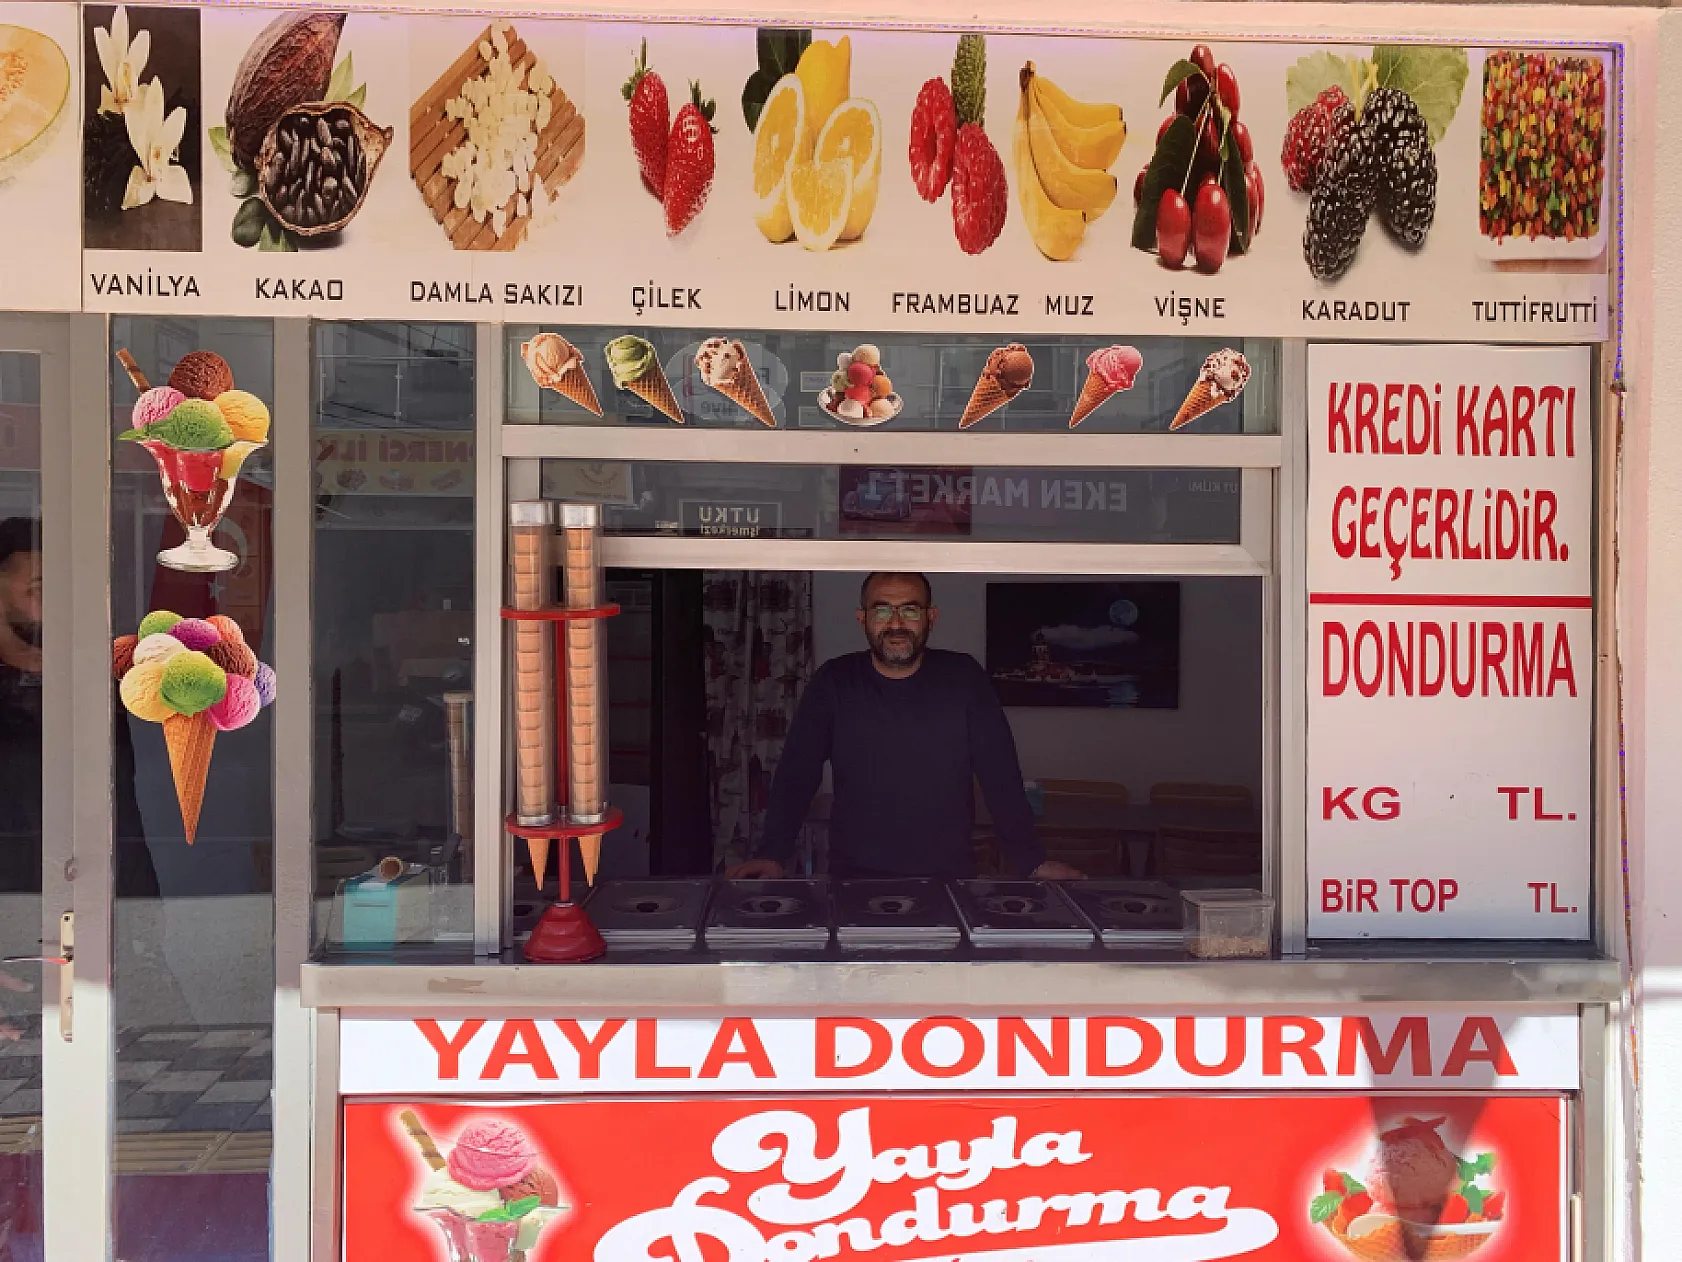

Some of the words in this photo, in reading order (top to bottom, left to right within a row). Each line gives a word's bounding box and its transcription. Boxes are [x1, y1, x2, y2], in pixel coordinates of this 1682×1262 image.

[91, 269, 201, 298] VANİLYA
[255, 279, 344, 301] KAKAO
[411, 281, 494, 304] DAMLA
[504, 284, 584, 306] SAKIZI
[631, 283, 703, 315] ÇİLEK
[775, 284, 851, 313] LİMON
[892, 293, 1020, 316] FRAMBUAZ
[1045, 296, 1095, 317] MUZ
[1155, 291, 1226, 327] VİŞNE
[1302, 300, 1412, 322] KARADUT
[1456, 384, 1576, 458] KARTI
[1322, 620, 1578, 698] DONDURMA
[1322, 786, 1401, 821] KG
[1497, 786, 1577, 821] TL.
[1389, 879, 1459, 914] TOP
[1527, 882, 1578, 913] TL.
[412, 1018, 777, 1079] YAYLA
[816, 1016, 1519, 1079] DONDURMA
[711, 1106, 1093, 1225] Yayla
[592, 1176, 1262, 1262] Dondurma
